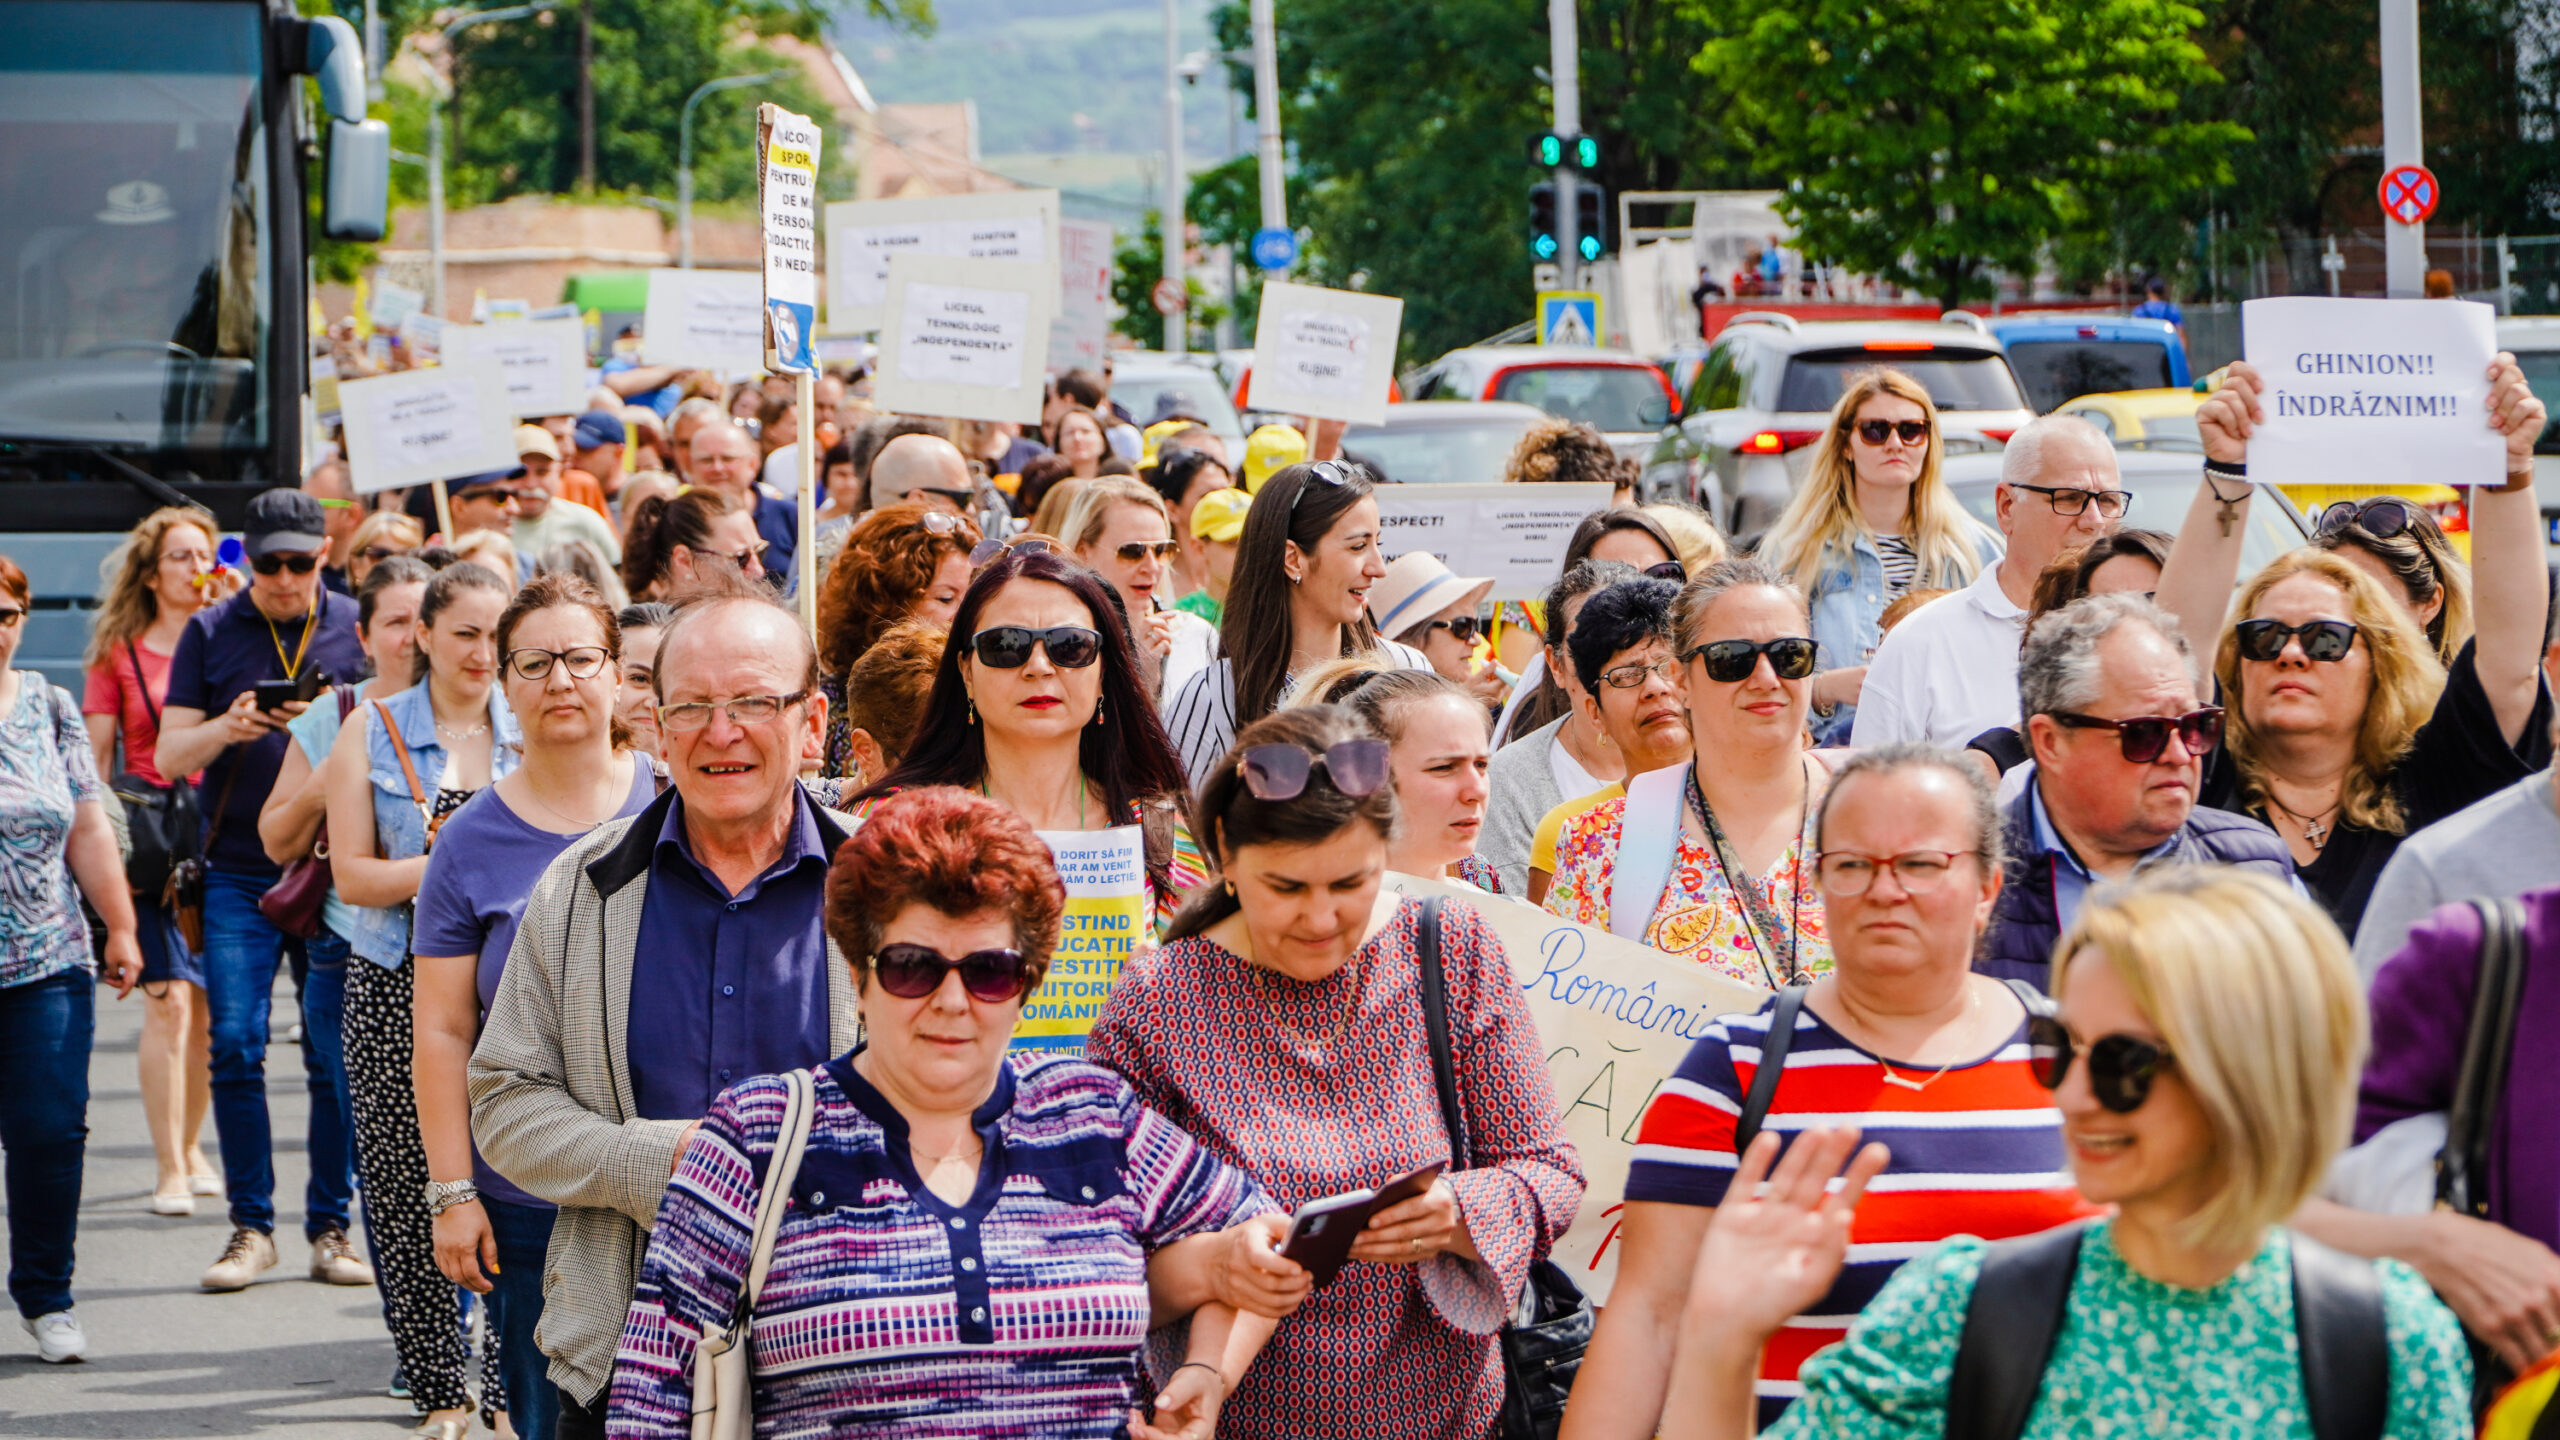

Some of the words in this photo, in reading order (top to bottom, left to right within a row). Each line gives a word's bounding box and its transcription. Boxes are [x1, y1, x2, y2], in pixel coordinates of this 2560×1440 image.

[782, 193, 796, 207] DE
[944, 301, 985, 315] LICEUL
[926, 318, 1001, 334] TEHNOLOGIC
[2295, 352, 2435, 376] GHINION!!
[2276, 389, 2458, 418] ÎNDRĂZNIM!!
[1496, 512, 1526, 520] LICEUL
[1060, 850, 1098, 860] DORIT
[1117, 847, 1133, 857] FIM
[1080, 863, 1100, 872] AM
[1103, 860, 1132, 871] VENIT
[1087, 875, 1097, 884] O
[1062, 914, 1131, 931] STIND
[1022, 1000, 1104, 1020] OMÂNI
